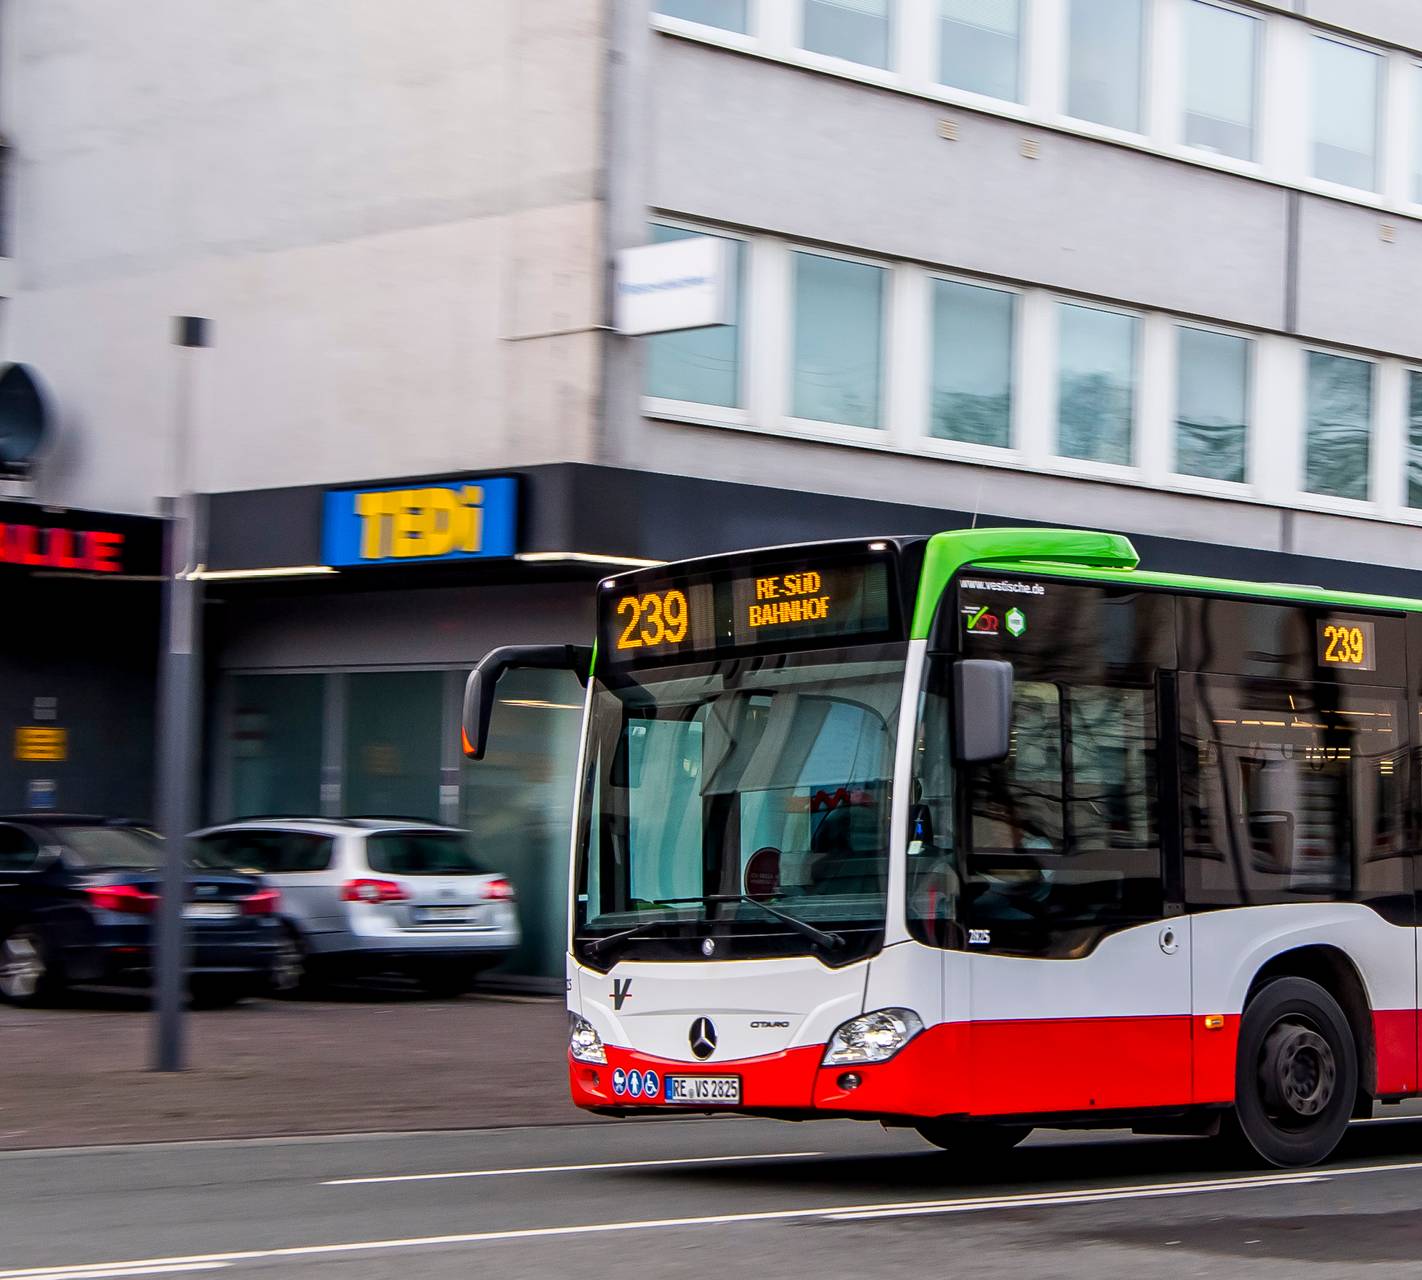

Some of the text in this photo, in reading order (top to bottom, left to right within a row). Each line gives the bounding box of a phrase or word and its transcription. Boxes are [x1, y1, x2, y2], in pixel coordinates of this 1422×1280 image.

[355, 485, 483, 559] TEDi
[756, 571, 821, 600] RE-SÜD
[960, 579, 1045, 595] www.vestische.de
[617, 590, 688, 649] 239
[749, 597, 829, 627] BAHNHOF
[1324, 626, 1363, 664] 239
[673, 1080, 738, 1098] RE VS 2825
